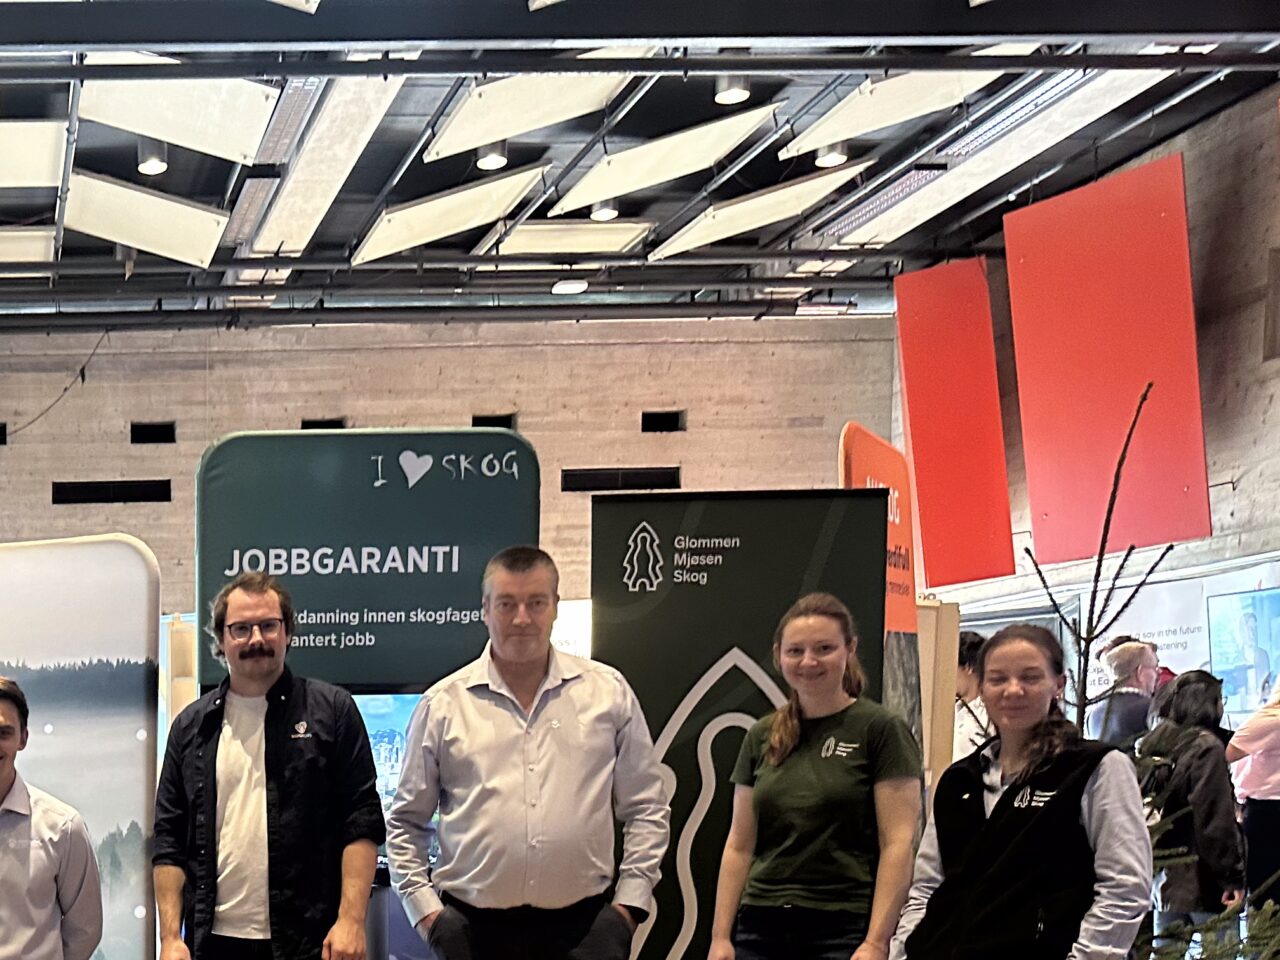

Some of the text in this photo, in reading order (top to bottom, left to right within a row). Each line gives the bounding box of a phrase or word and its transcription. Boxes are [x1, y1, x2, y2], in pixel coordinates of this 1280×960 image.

[371, 451, 519, 487] I SKOG
[674, 536, 740, 549] Glommen
[224, 546, 460, 576] JOBBGARANTI
[673, 553, 722, 568] Mjøsen
[673, 570, 708, 585] Skog
[294, 608, 360, 627] tdanning
[364, 608, 405, 622] innen
[340, 632, 376, 650] jobb
